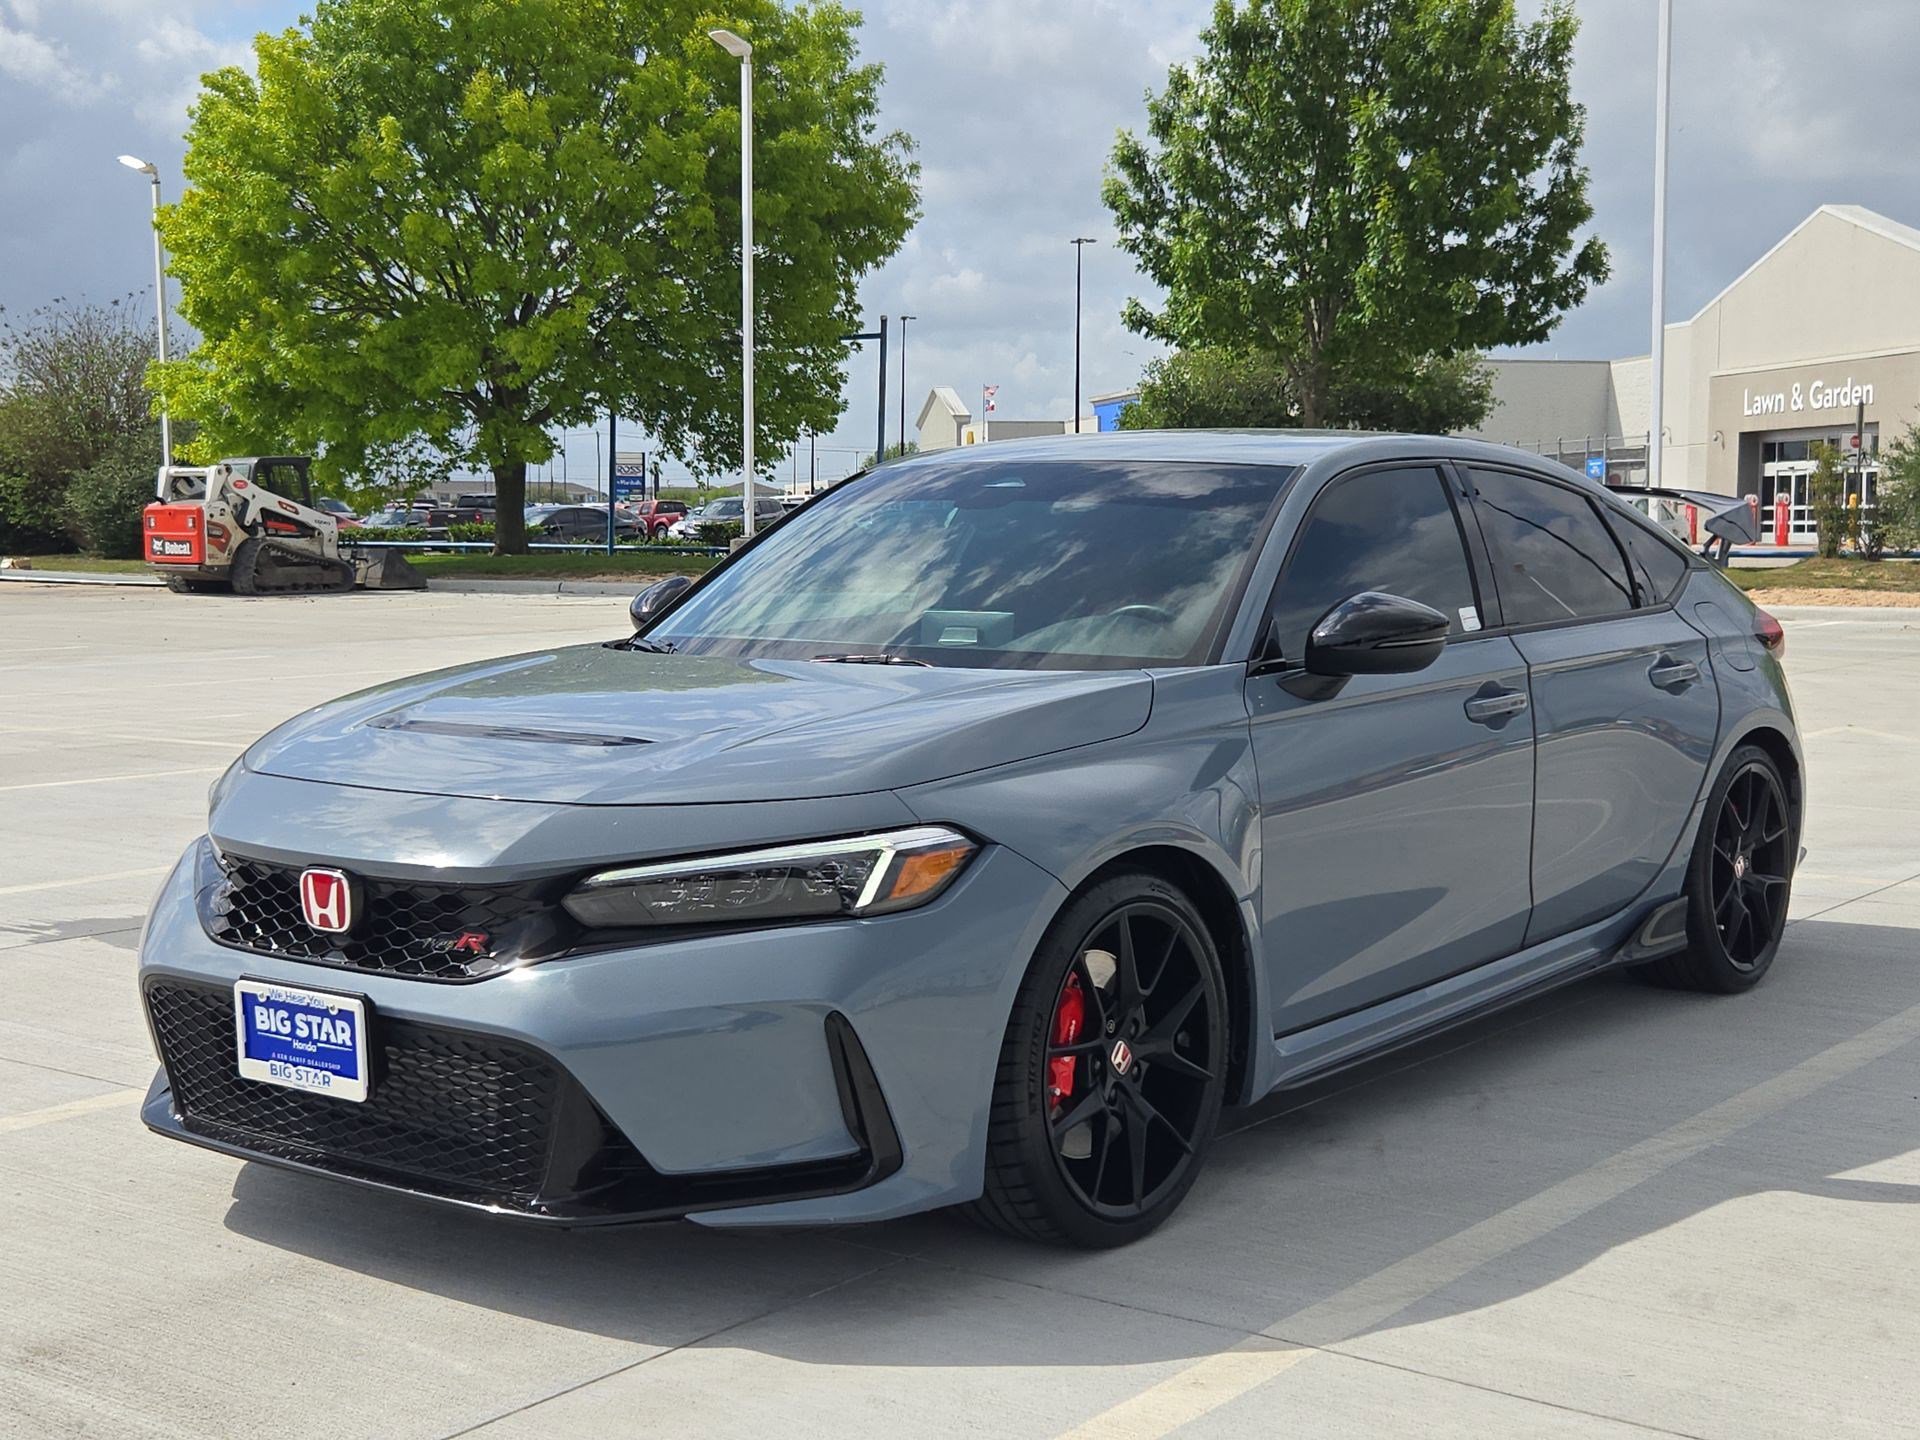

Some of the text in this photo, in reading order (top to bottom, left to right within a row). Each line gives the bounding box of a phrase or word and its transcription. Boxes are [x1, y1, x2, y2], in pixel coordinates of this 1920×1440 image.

[1743, 376, 1874, 416] Lawn & Garden
[616, 465, 641, 474] ROSS
[164, 541, 191, 555] Bobcat
[454, 932, 488, 954] R
[254, 1005, 353, 1046] BIG STAR
[293, 1039, 317, 1052] Honda
[270, 1063, 331, 1087] BIG STAR
